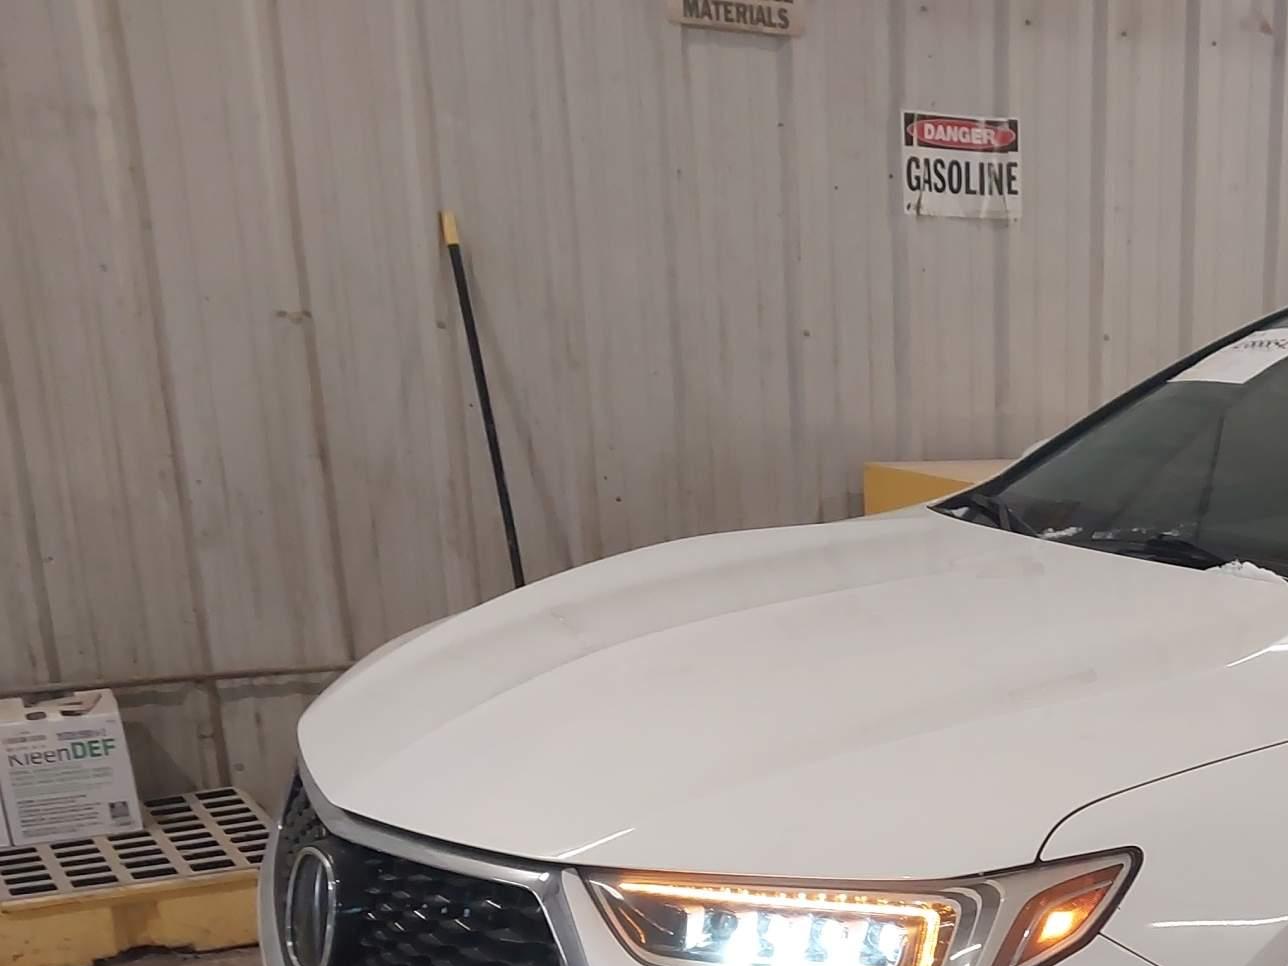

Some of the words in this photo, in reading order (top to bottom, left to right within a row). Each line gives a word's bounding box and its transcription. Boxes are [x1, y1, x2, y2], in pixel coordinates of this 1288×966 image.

[682, 0, 790, 29] MATERIALS
[923, 123, 997, 145] DANGER
[906, 156, 1019, 196] GASOLINE
